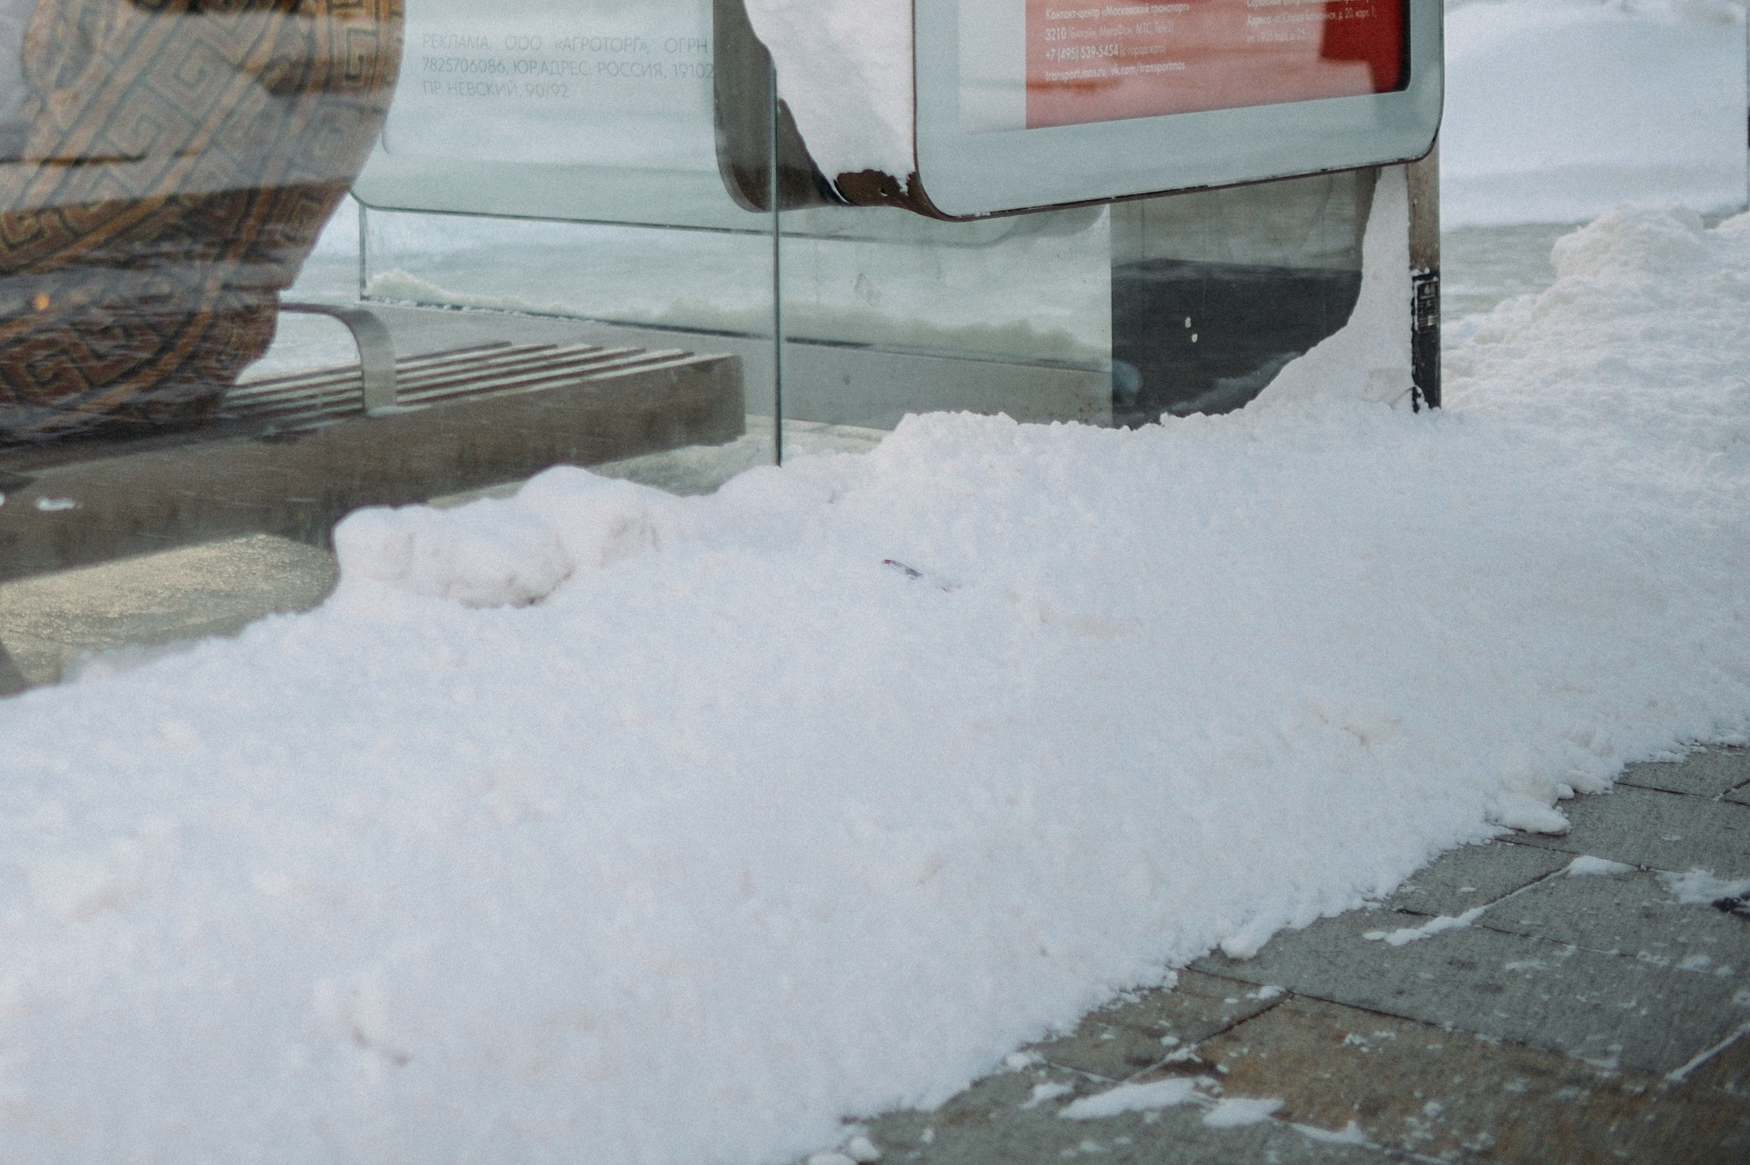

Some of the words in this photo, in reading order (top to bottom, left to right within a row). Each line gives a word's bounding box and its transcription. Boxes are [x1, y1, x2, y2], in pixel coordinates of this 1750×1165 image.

[1045, 28, 1067, 41] 3210
[505, 36, 542, 51] ООО
[1045, 48, 1055, 61] +7
[1057, 46, 1079, 62] (495)
